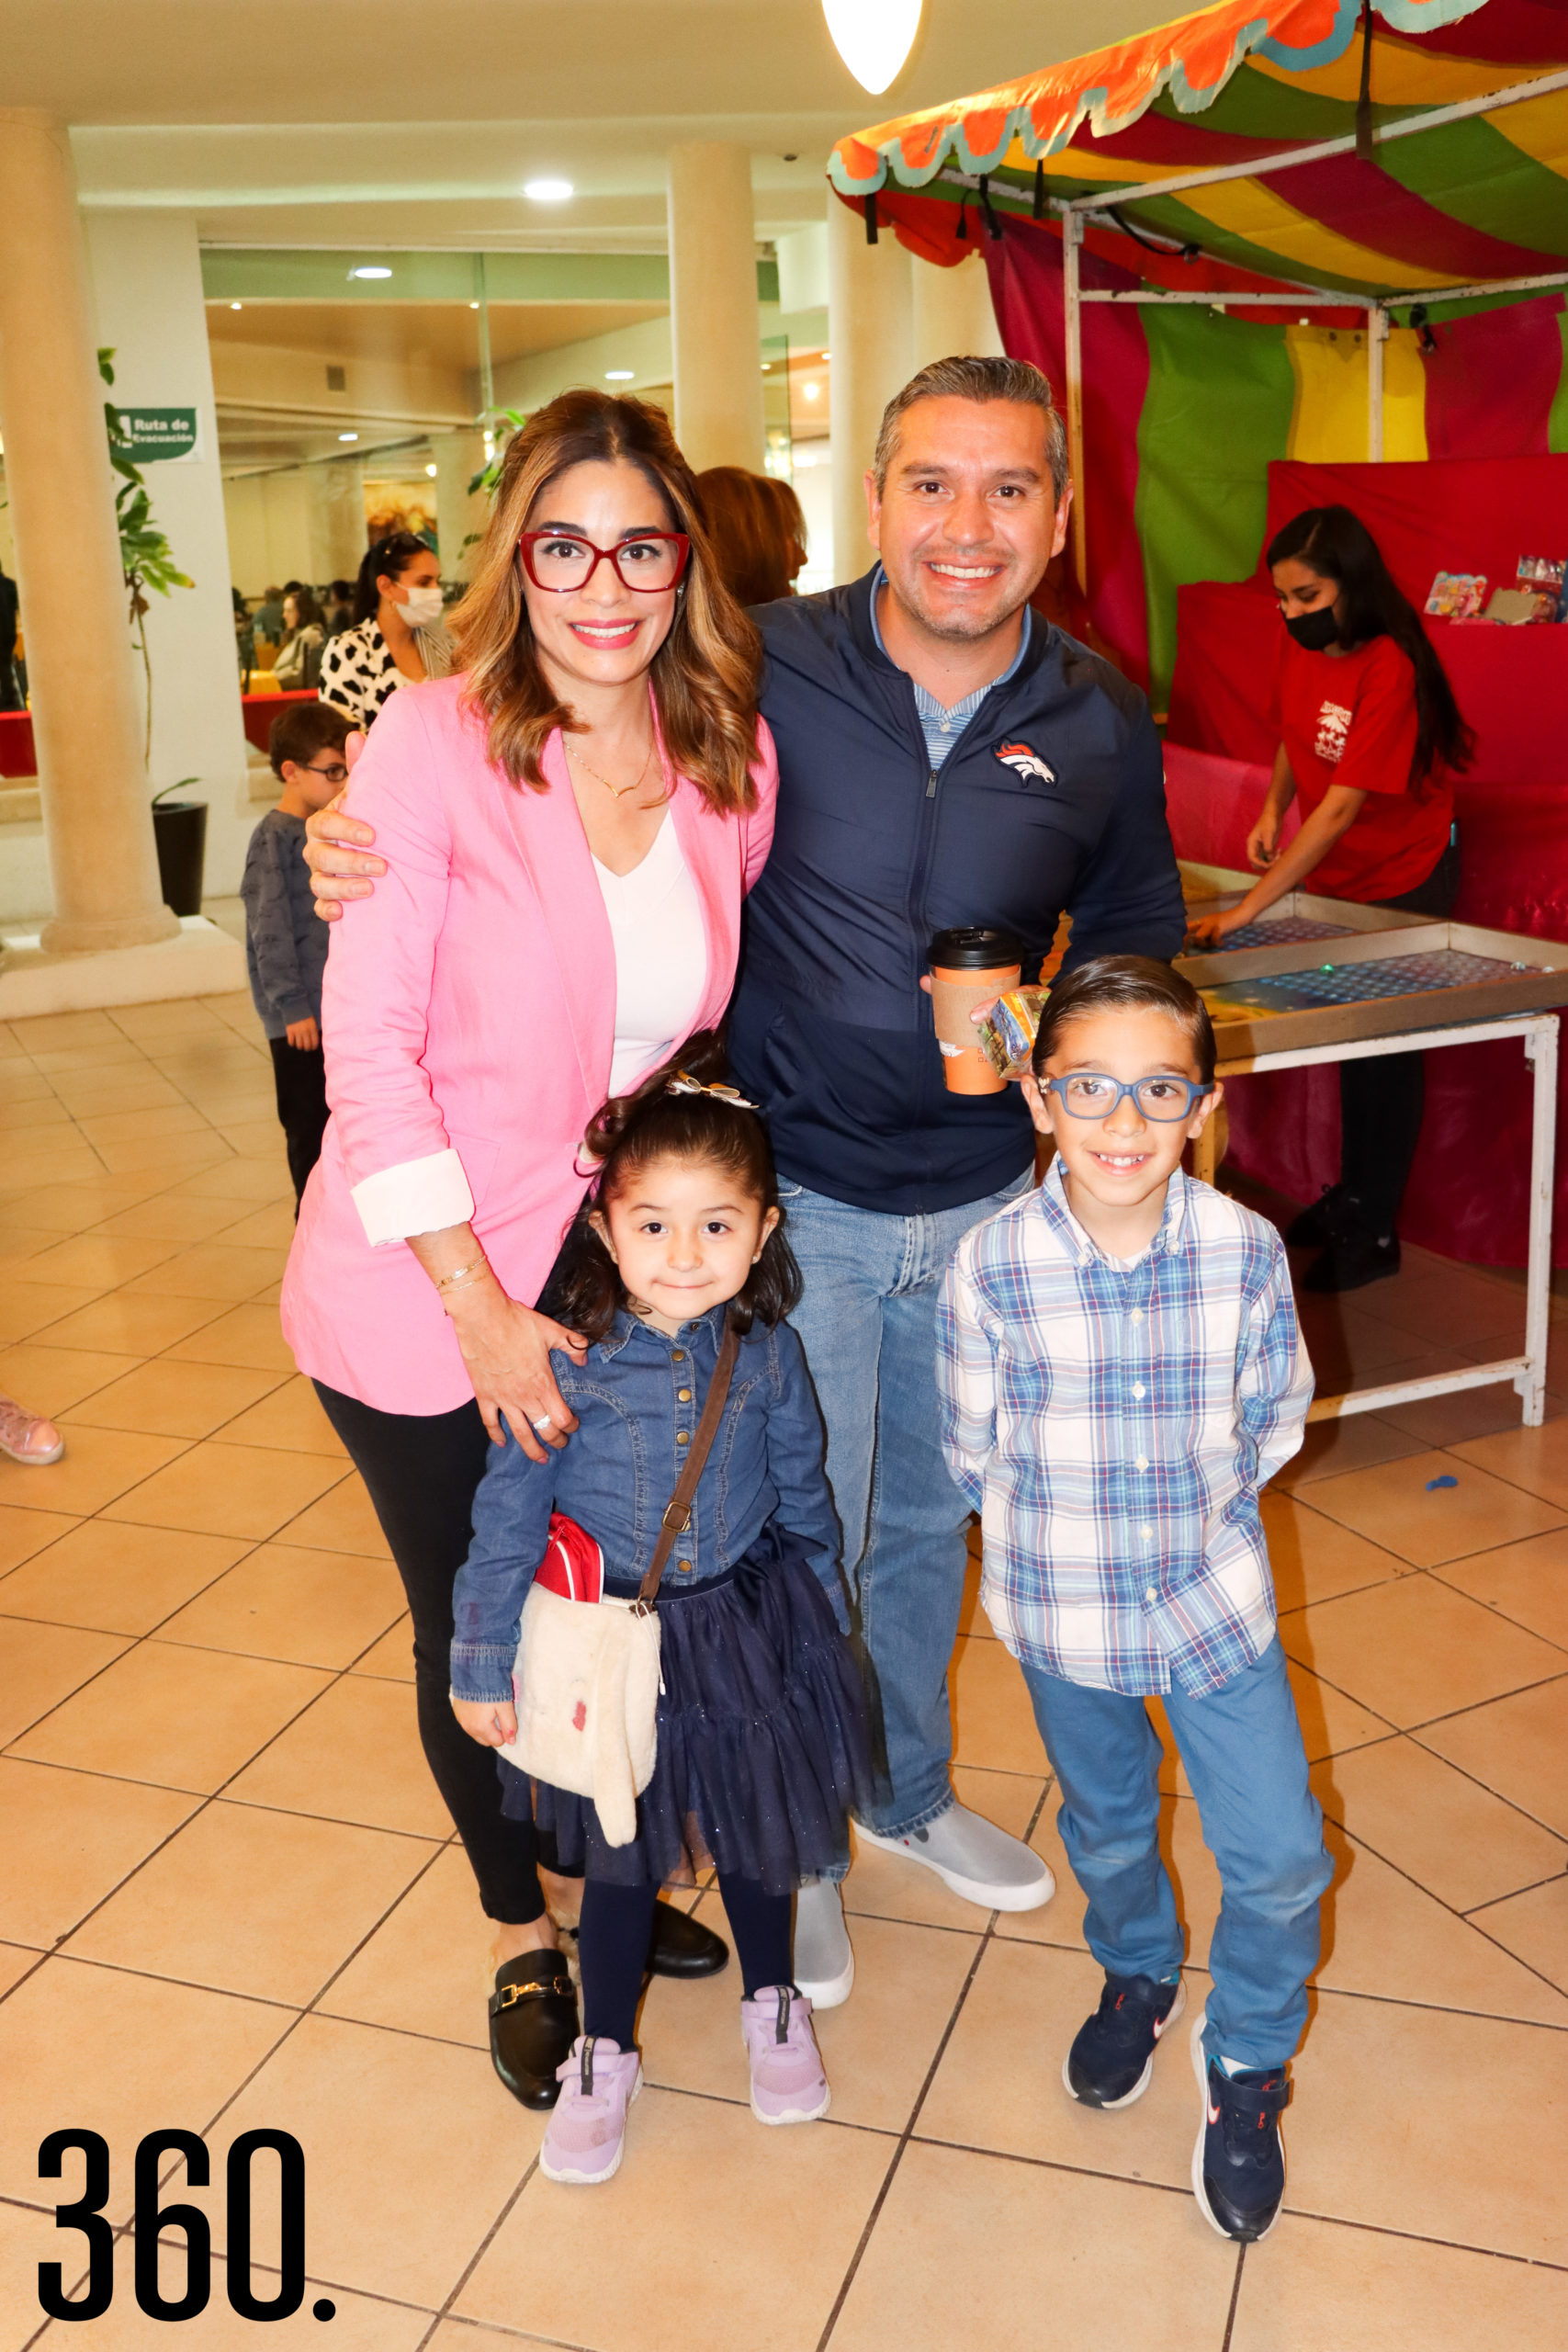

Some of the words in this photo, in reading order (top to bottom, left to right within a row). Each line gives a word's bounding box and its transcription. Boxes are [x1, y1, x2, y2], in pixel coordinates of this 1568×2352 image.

[134, 418, 168, 431] Ruta
[171, 418, 189, 431] de
[132, 434, 194, 444] Evacuación
